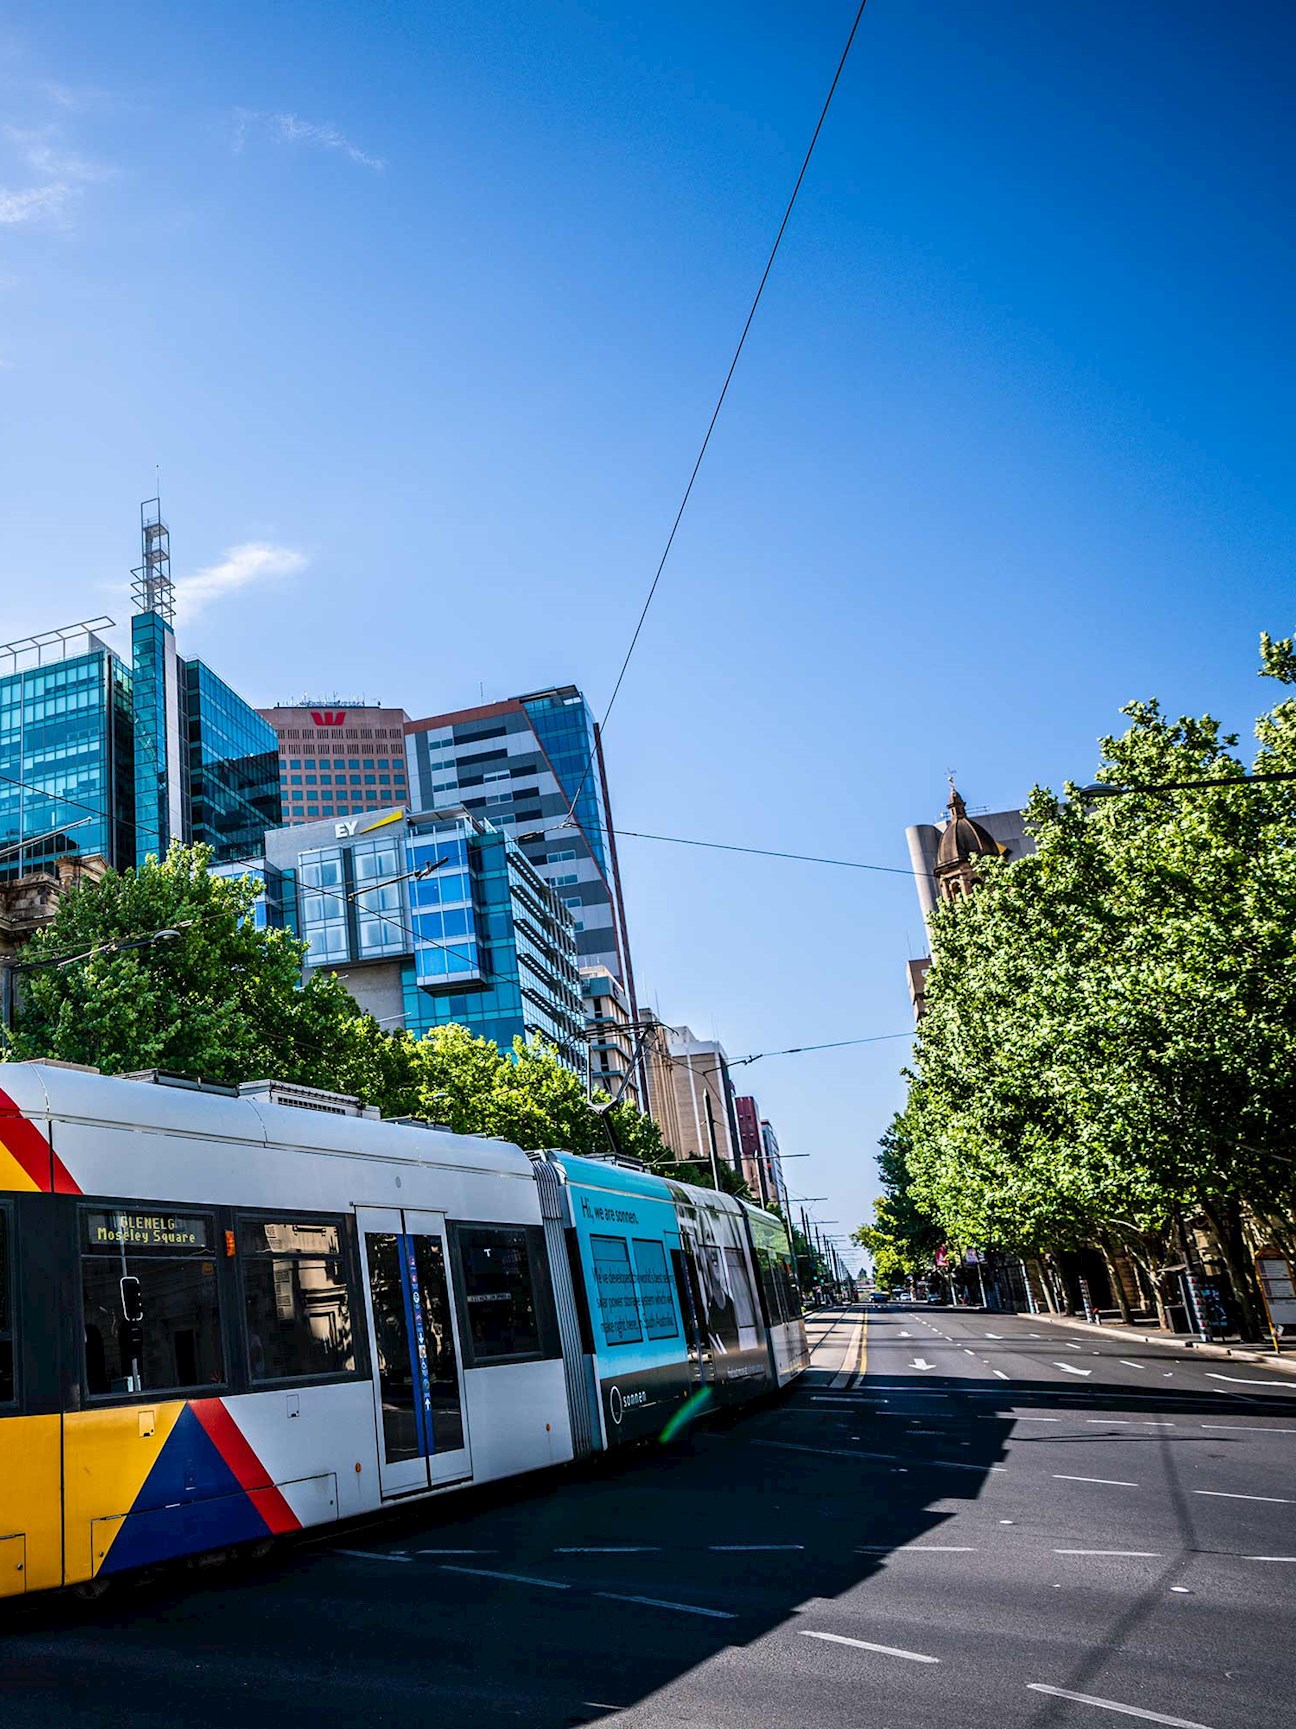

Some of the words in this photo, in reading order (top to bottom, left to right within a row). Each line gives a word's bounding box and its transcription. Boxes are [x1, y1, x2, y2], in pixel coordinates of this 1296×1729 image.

[335, 820, 358, 839] EY
[594, 1206, 604, 1220] we
[604, 1208, 615, 1222] are
[121, 1216, 175, 1230] GLENELG
[97, 1227, 149, 1243] Moseley
[153, 1230, 196, 1244] Square
[623, 1391, 647, 1408] sonnen
